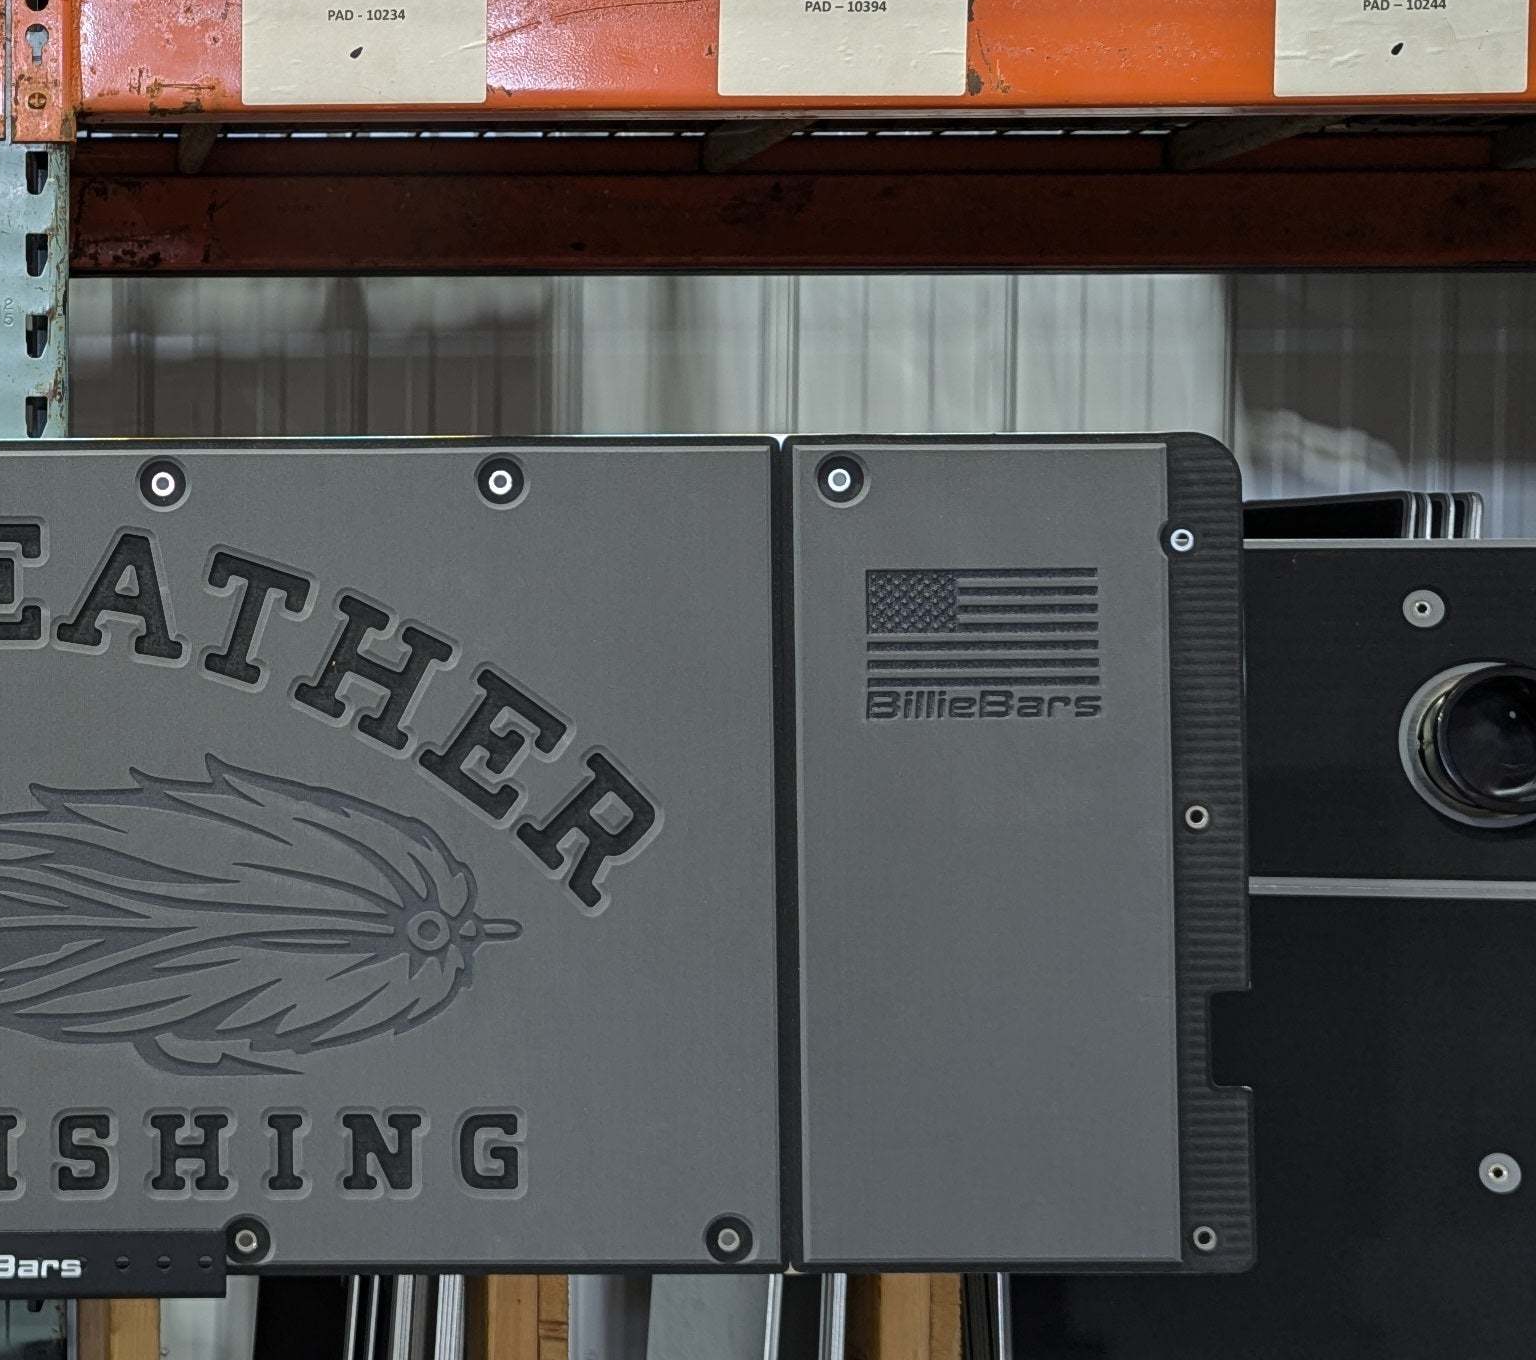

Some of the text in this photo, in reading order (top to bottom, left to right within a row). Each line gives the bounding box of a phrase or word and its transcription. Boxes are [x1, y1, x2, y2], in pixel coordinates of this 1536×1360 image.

[804, 0, 832, 13] PAD
[847, 0, 888, 13] 10394
[1363, 0, 1391, 12] PAD
[327, 9, 354, 22] PAD
[366, 8, 406, 21] 10234
[866, 690, 1102, 720] BillieBars
